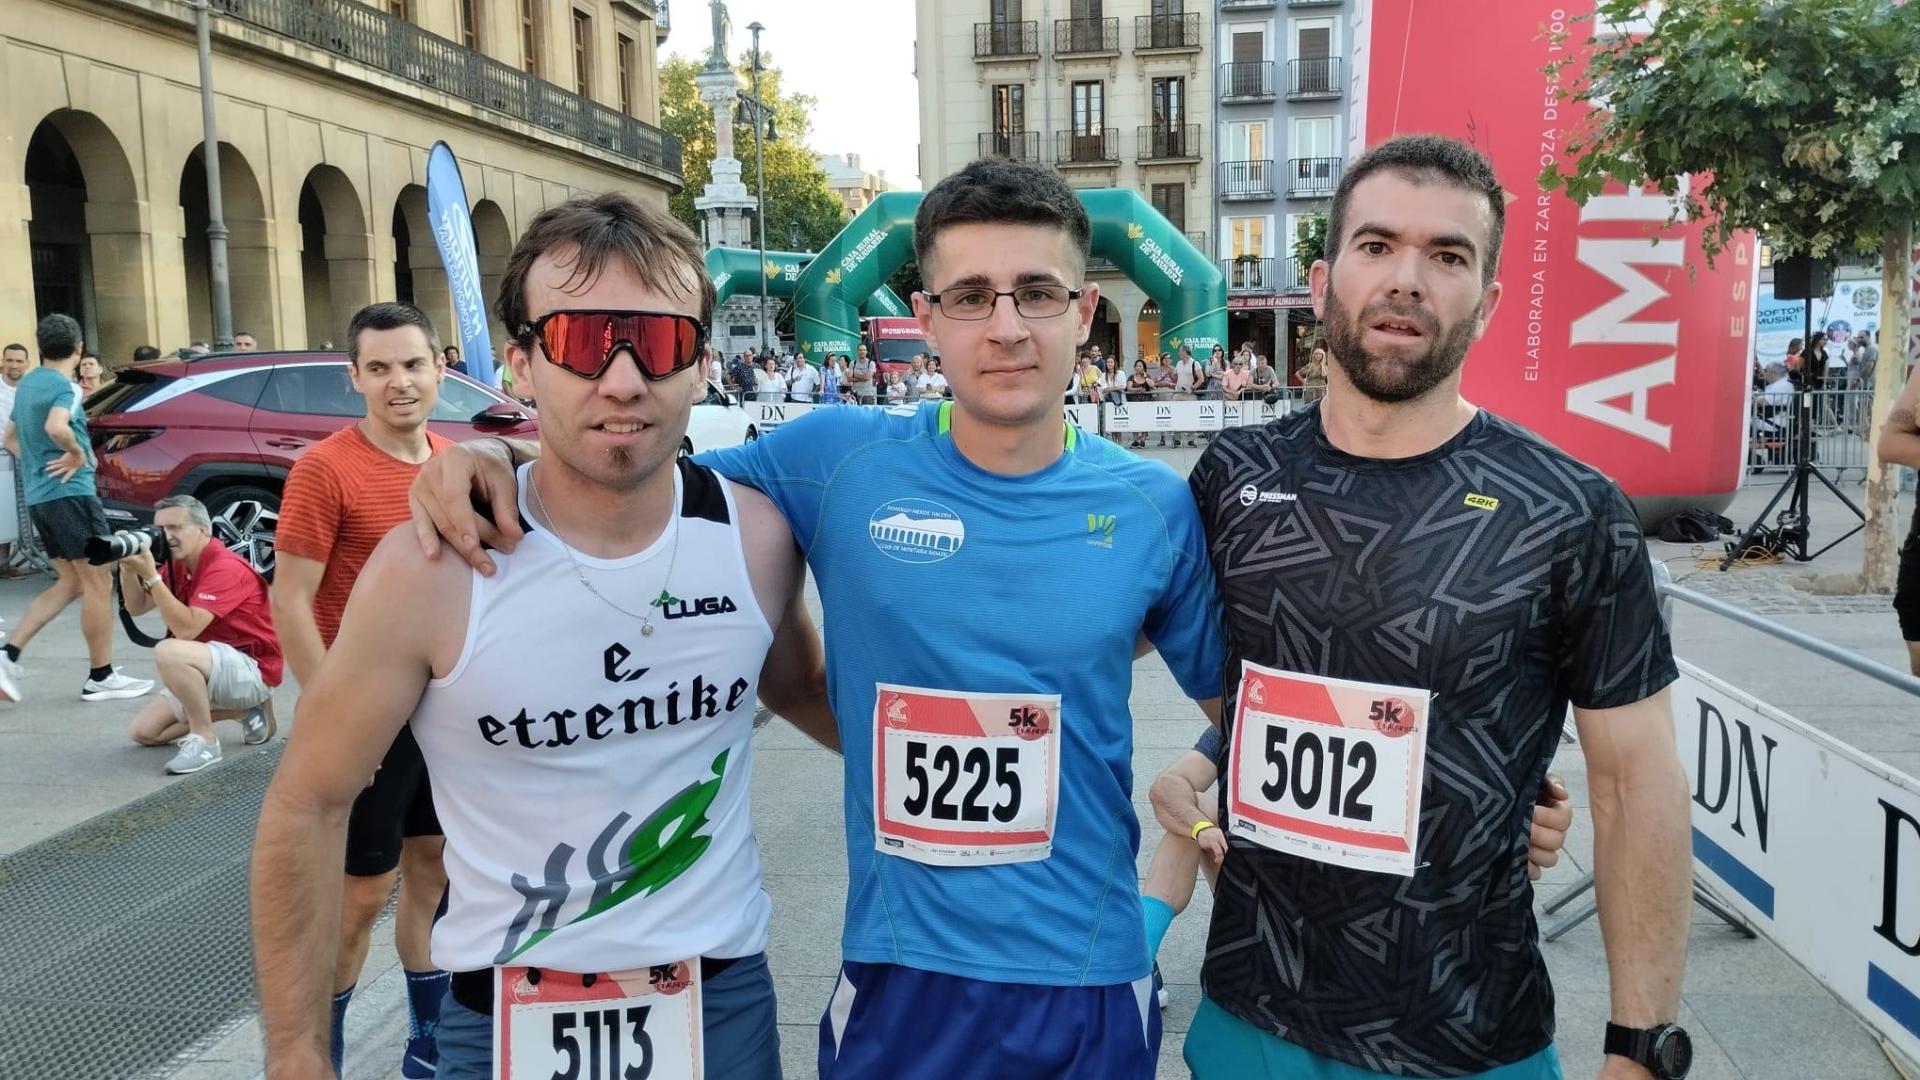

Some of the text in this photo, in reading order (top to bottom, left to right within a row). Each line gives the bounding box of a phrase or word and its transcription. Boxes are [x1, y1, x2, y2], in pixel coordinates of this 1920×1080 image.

[1549, 9, 1565, 52] 100
[1535, 128, 1556, 231] ZAROZA
[1533, 239, 1548, 262] EN
[1525, 270, 1546, 381] ELABORADA
[761, 405, 786, 421] DN
[1063, 409, 1080, 425] N
[1114, 406, 1129, 416] DN
[1156, 405, 1172, 415] DN
[1200, 404, 1215, 414] DN
[1224, 405, 1240, 415] DN
[1466, 495, 1497, 508] 42K
[662, 596, 737, 619] LUGA
[477, 674, 749, 749] etxenike
[1008, 707, 1037, 727] 5k
[1369, 700, 1402, 724] 5k
[904, 741, 1022, 823] 5225
[1261, 724, 1377, 822] 5012
[1692, 697, 1778, 854] DN
[551, 1005, 654, 1080] 5113
